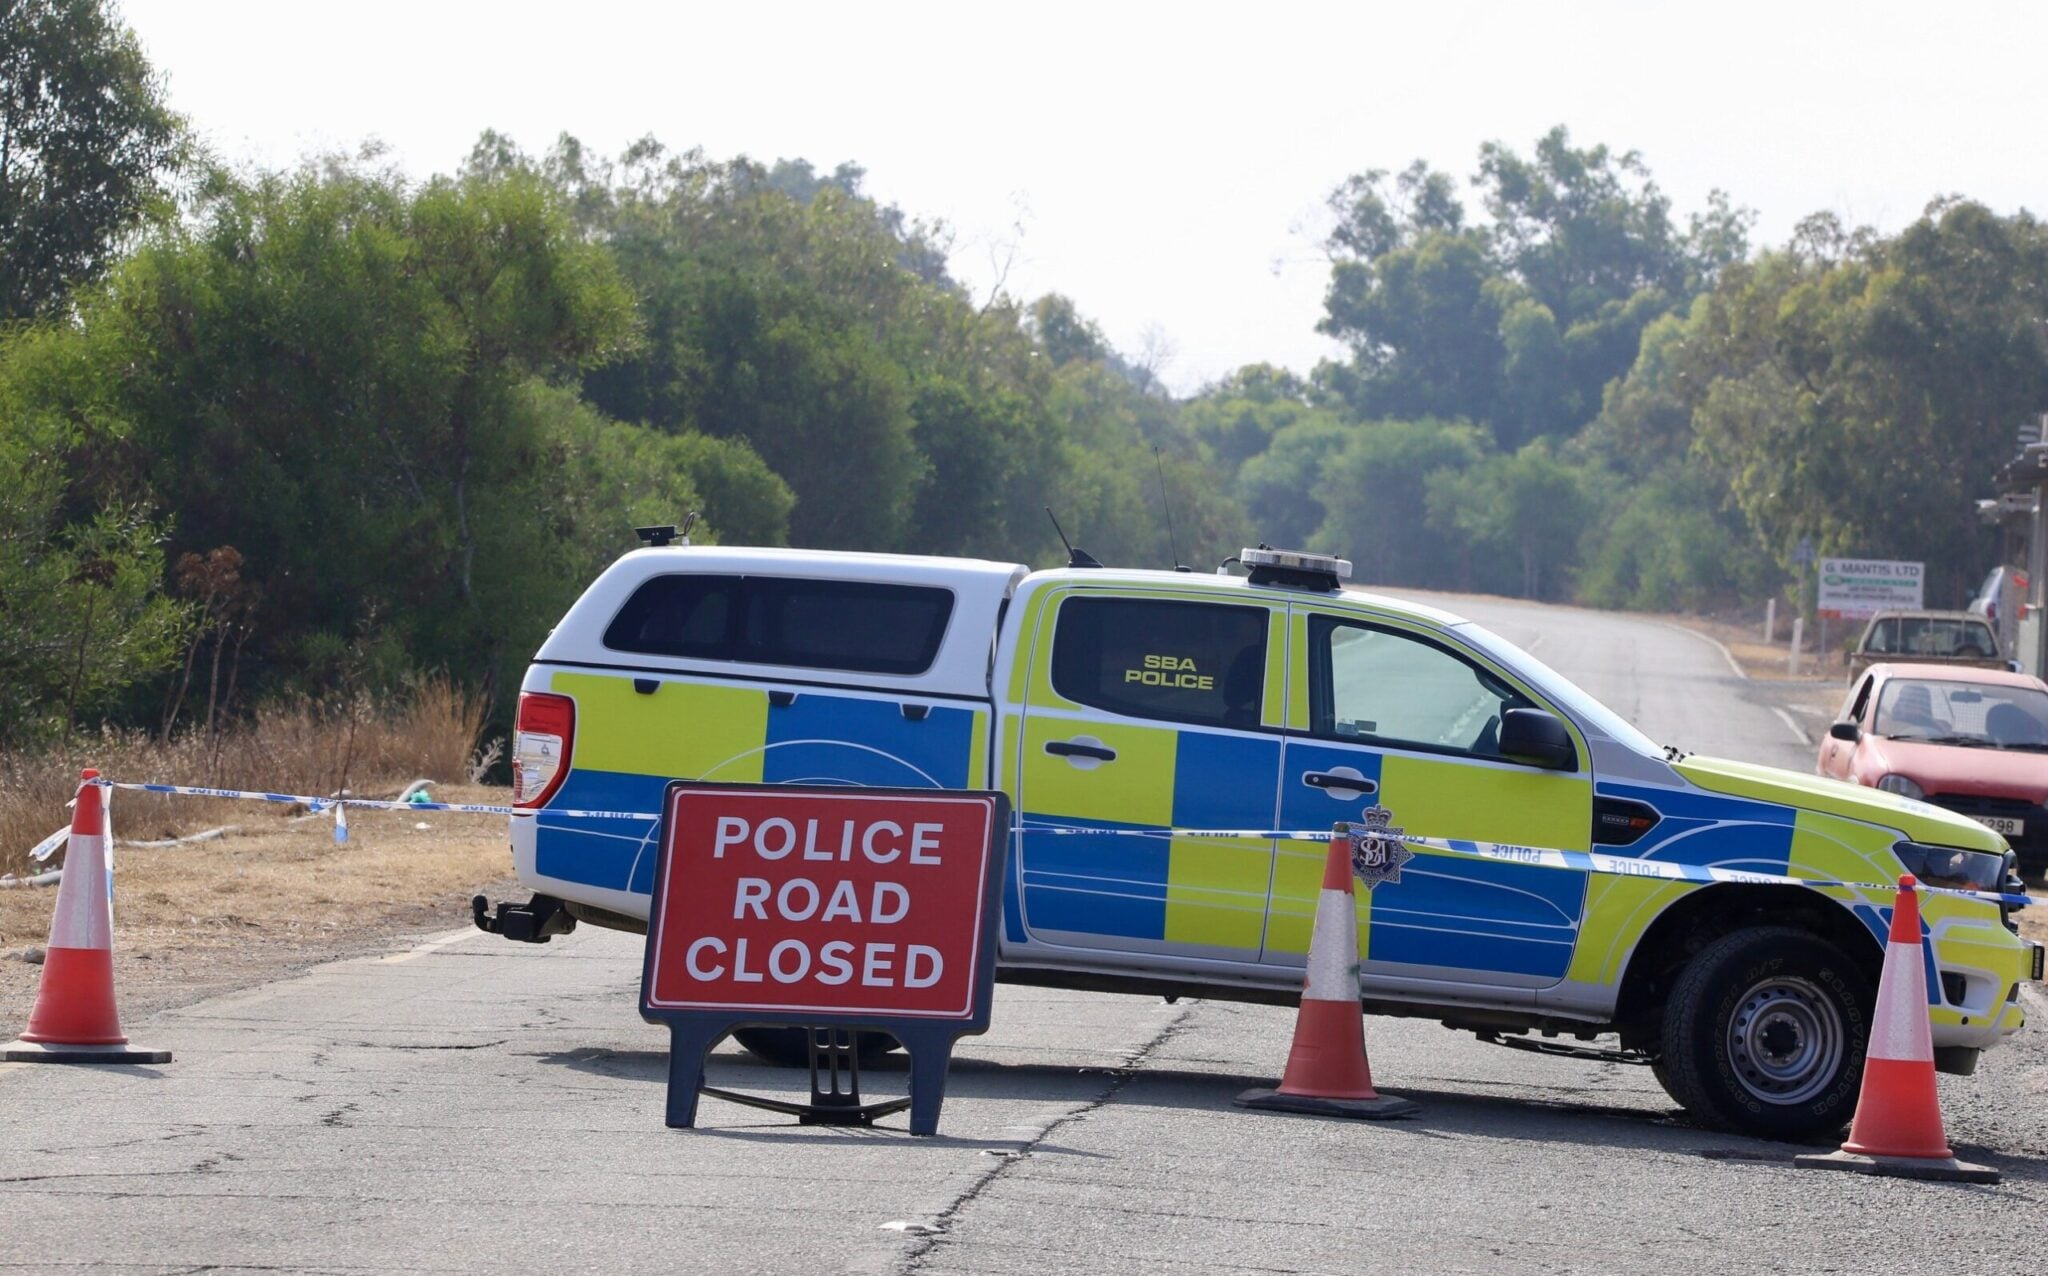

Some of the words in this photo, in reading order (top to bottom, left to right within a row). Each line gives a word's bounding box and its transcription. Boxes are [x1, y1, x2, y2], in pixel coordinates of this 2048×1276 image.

[1841, 563, 1890, 576] MANTIS
[1895, 565, 1919, 577] LTD
[1144, 654, 1197, 672] SBA
[1125, 669, 1214, 690] POLICE
[713, 816, 944, 865] POLICE
[1491, 844, 1542, 863] POLICE
[1609, 860, 1661, 877] POLICE
[733, 877, 911, 924] ROAD
[685, 936, 944, 988] CLOSED
